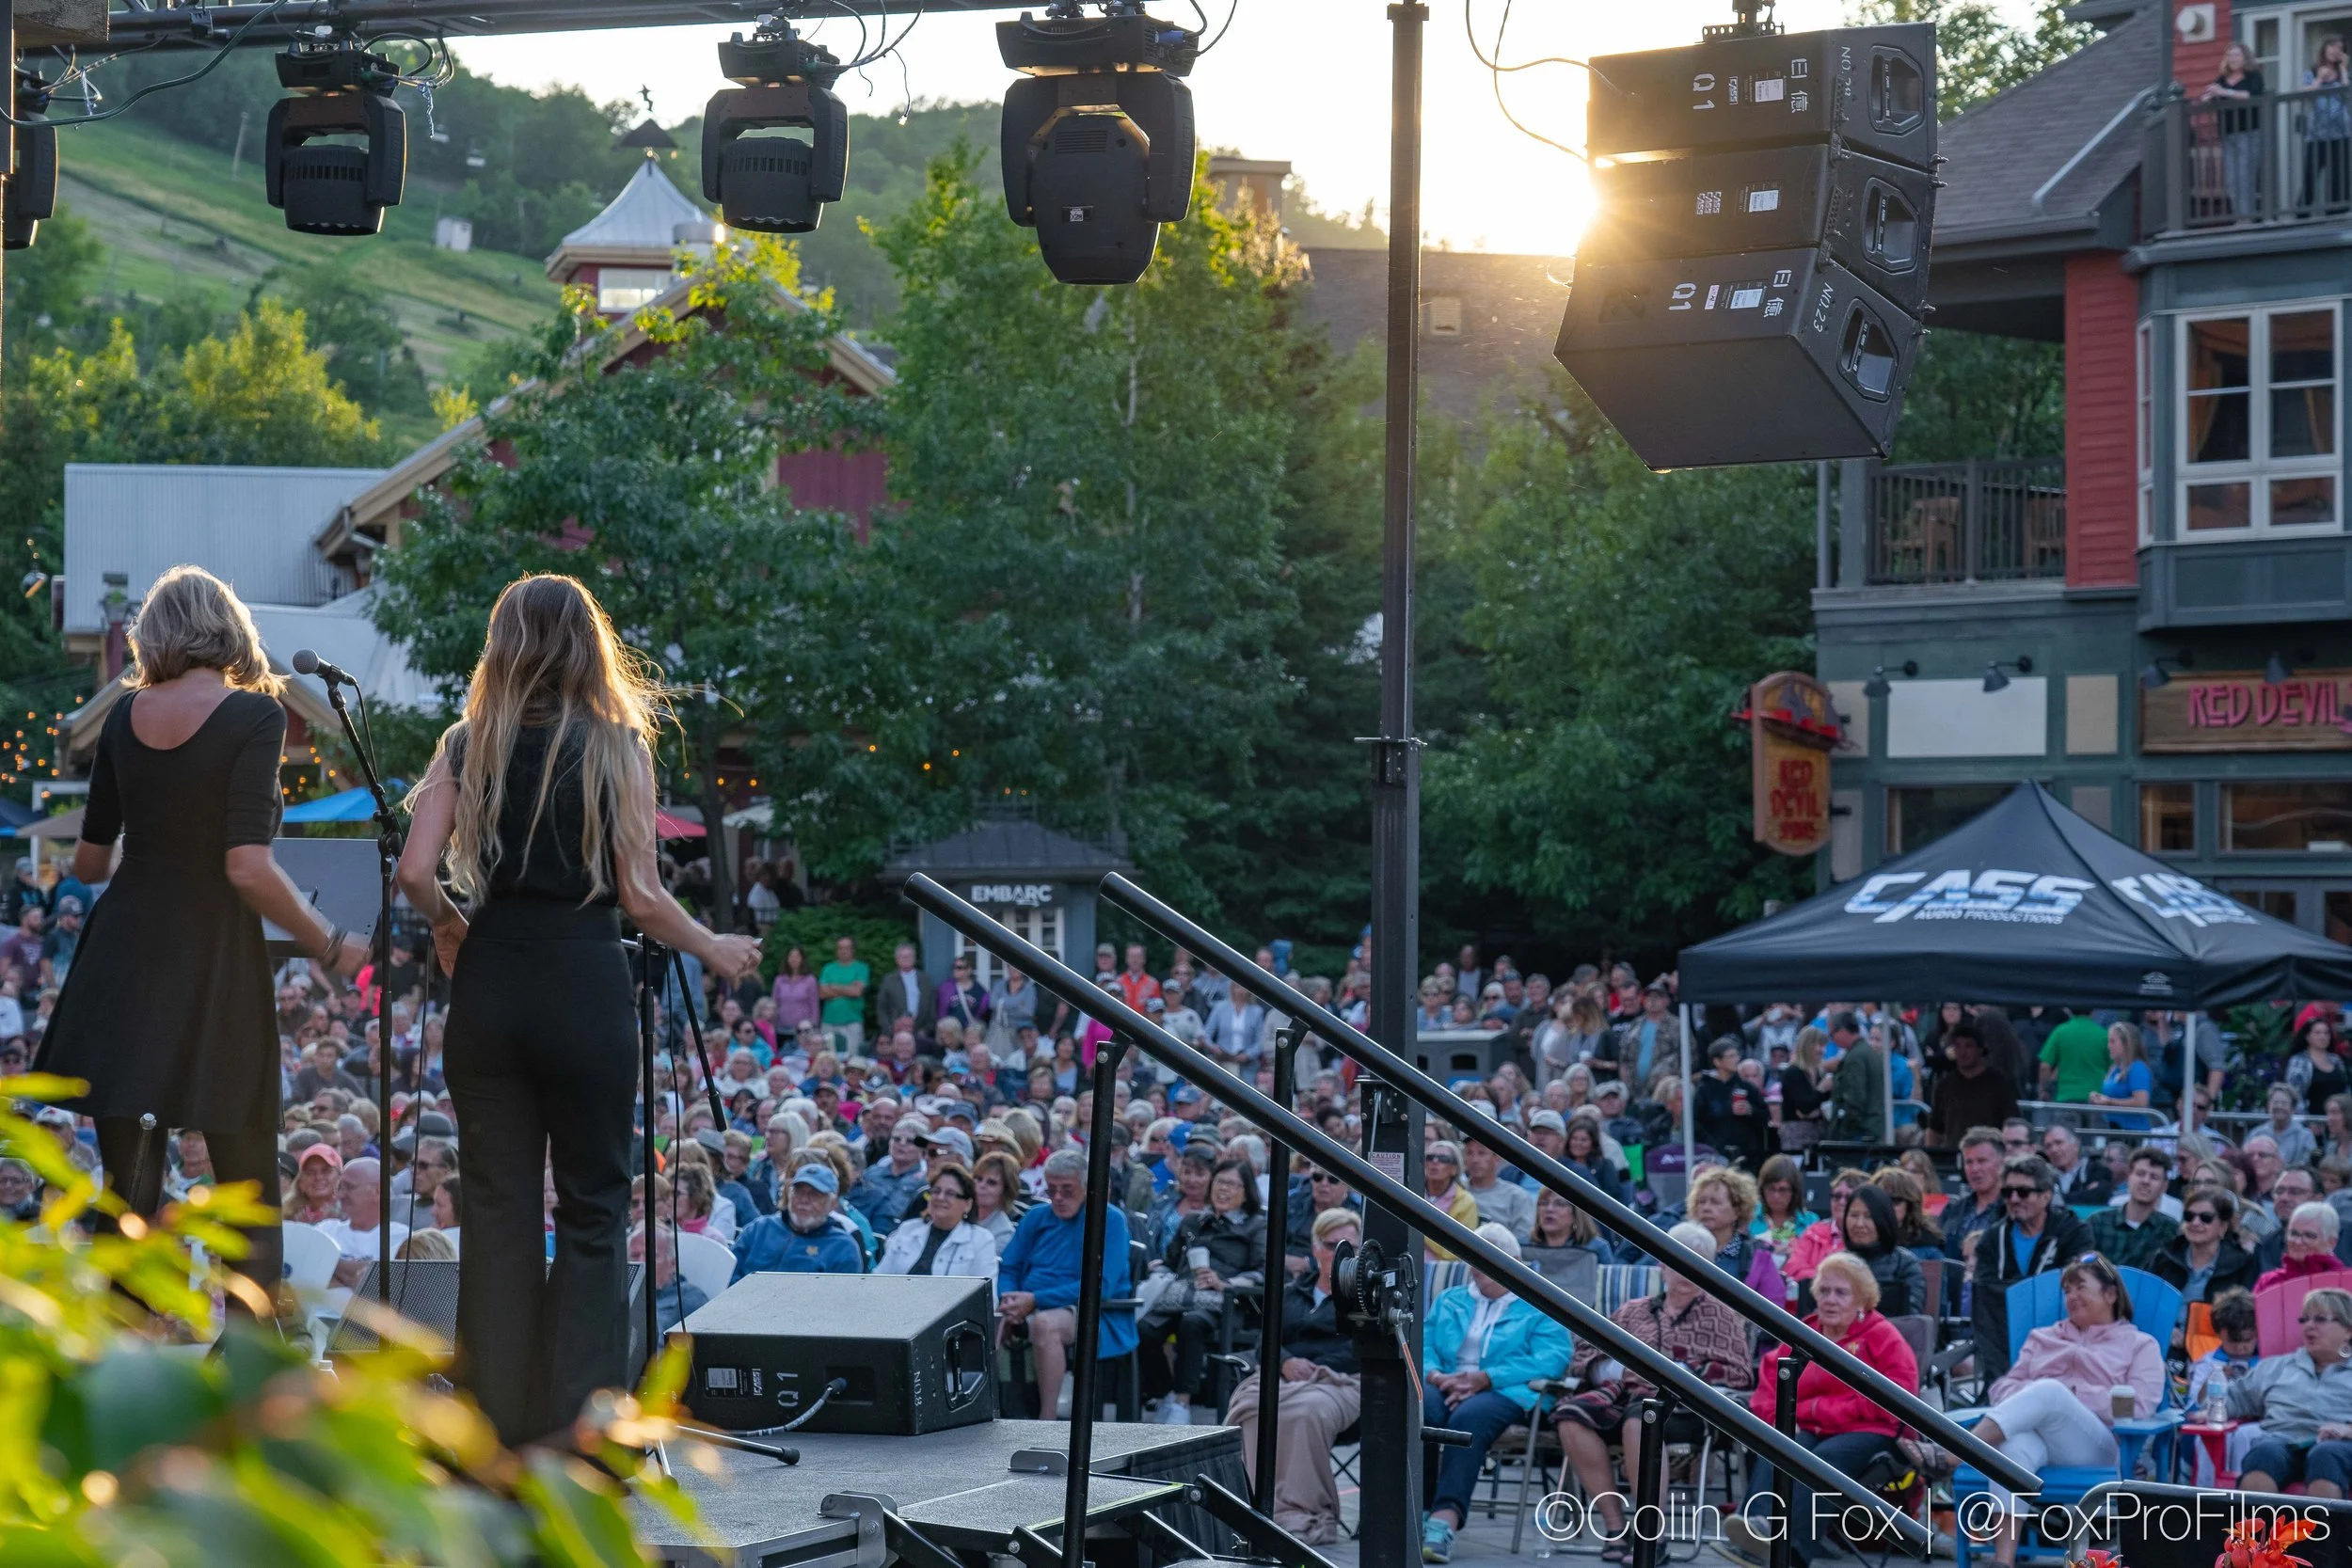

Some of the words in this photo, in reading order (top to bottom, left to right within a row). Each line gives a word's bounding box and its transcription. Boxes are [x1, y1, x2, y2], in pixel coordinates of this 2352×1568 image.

[1692, 73, 1715, 110] Q1
[1668, 282, 1696, 311] Q1
[1813, 282, 1835, 333] NO.23
[2188, 684, 2252, 728] RED
[1779, 760, 1812, 786] RED
[1771, 786, 1821, 817] DEVIL
[971, 884, 1053, 905] EMBARC
[1844, 868, 2096, 925] CASS
[1914, 909, 1963, 921] AUDIO
[1963, 910, 2065, 926] PRODUCTIONS
[753, 1370, 762, 1394] CASS
[776, 1372, 799, 1407] Q1
